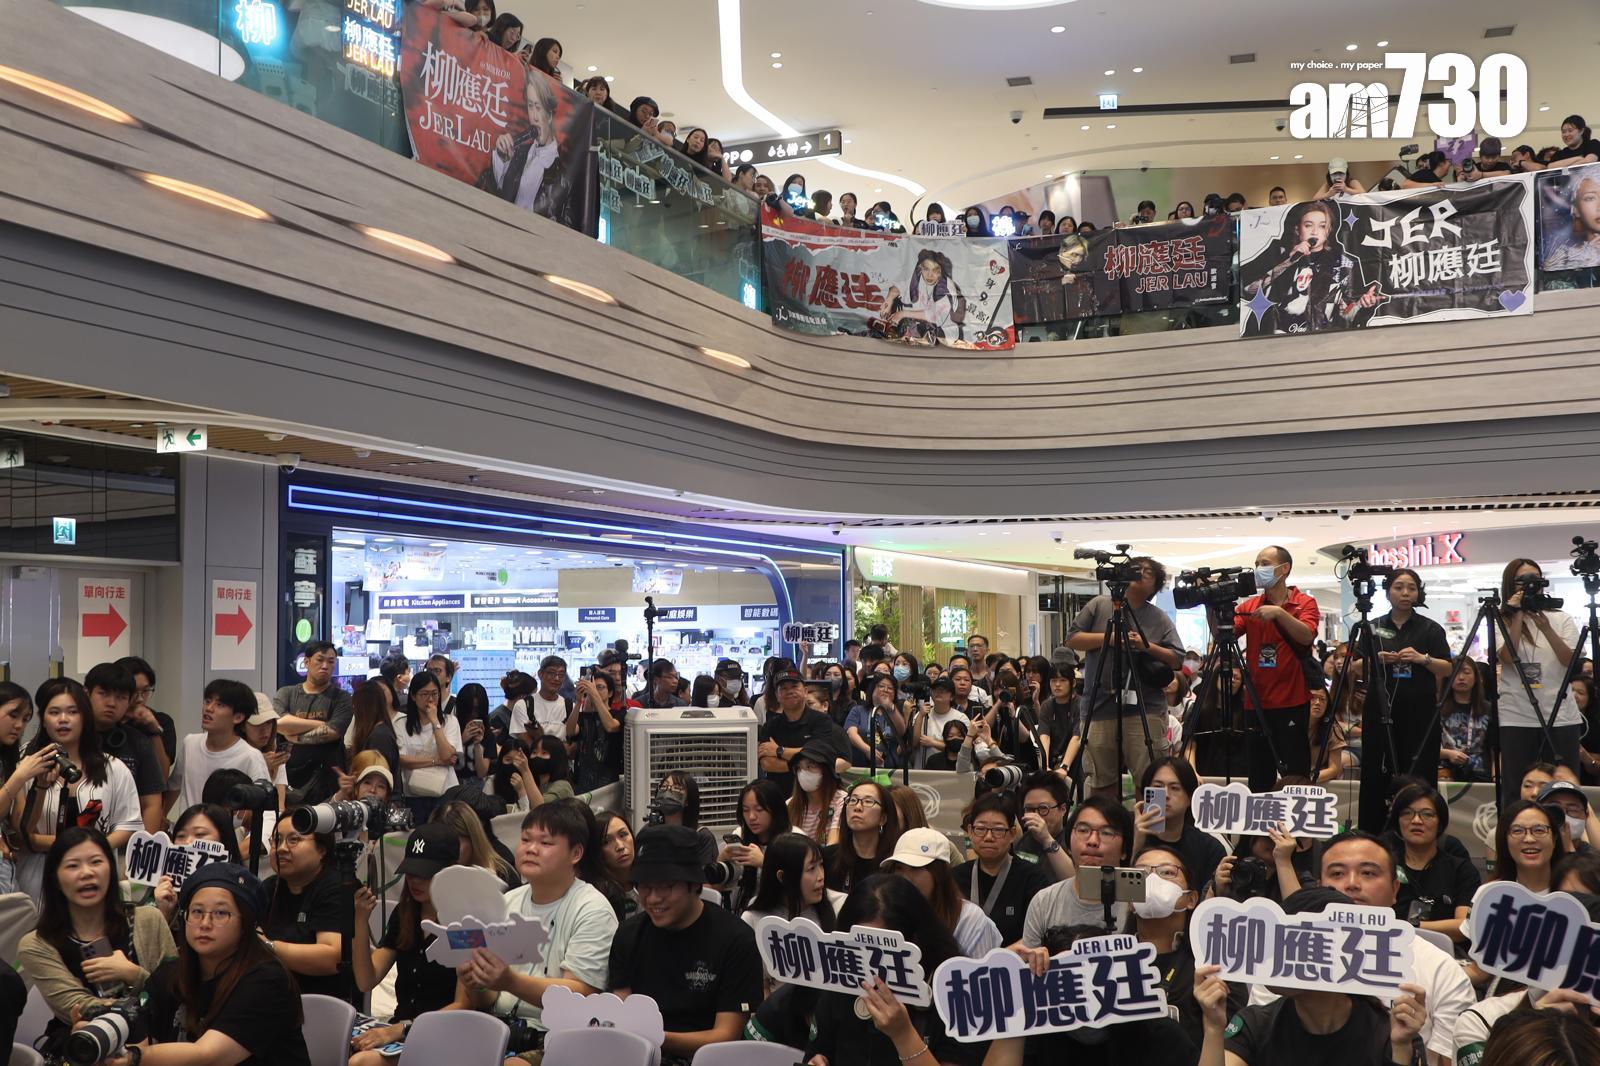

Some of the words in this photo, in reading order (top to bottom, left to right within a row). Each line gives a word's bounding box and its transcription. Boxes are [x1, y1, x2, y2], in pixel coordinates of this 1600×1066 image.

[420, 41, 509, 128] 柳應廷
[921, 222, 966, 238] 柳應廷
[1361, 199, 1462, 249] JER
[1103, 236, 1207, 281] 柳應廷
[1388, 238, 1502, 289] 柳應廷
[783, 258, 886, 312] 柳應廷
[1136, 275, 1170, 295] JER
[1173, 271, 1208, 290] LAU
[83, 585, 126, 600] 單向行走
[216, 586, 253, 601] 單向行走
[411, 598, 431, 606] Kitchen
[431, 598, 461, 607] Appliances
[785, 625, 832, 643] 柳應廷
[1284, 786, 1302, 795] JER
[1304, 787, 1323, 796] LAU
[1196, 790, 1337, 836] 柳應廷
[192, 840, 207, 851] JER
[207, 843, 222, 853] LAU
[1328, 911, 1355, 924] JER
[1359, 912, 1386, 926] LAU
[854, 932, 874, 945] JER
[876, 936, 898, 948] LAU
[1073, 939, 1101, 956] JER
[1104, 936, 1133, 953] LAU
[1204, 913, 1404, 988] 柳應廷
[767, 929, 921, 999] 柳應廷
[945, 949, 1162, 1037] 柳應廷
